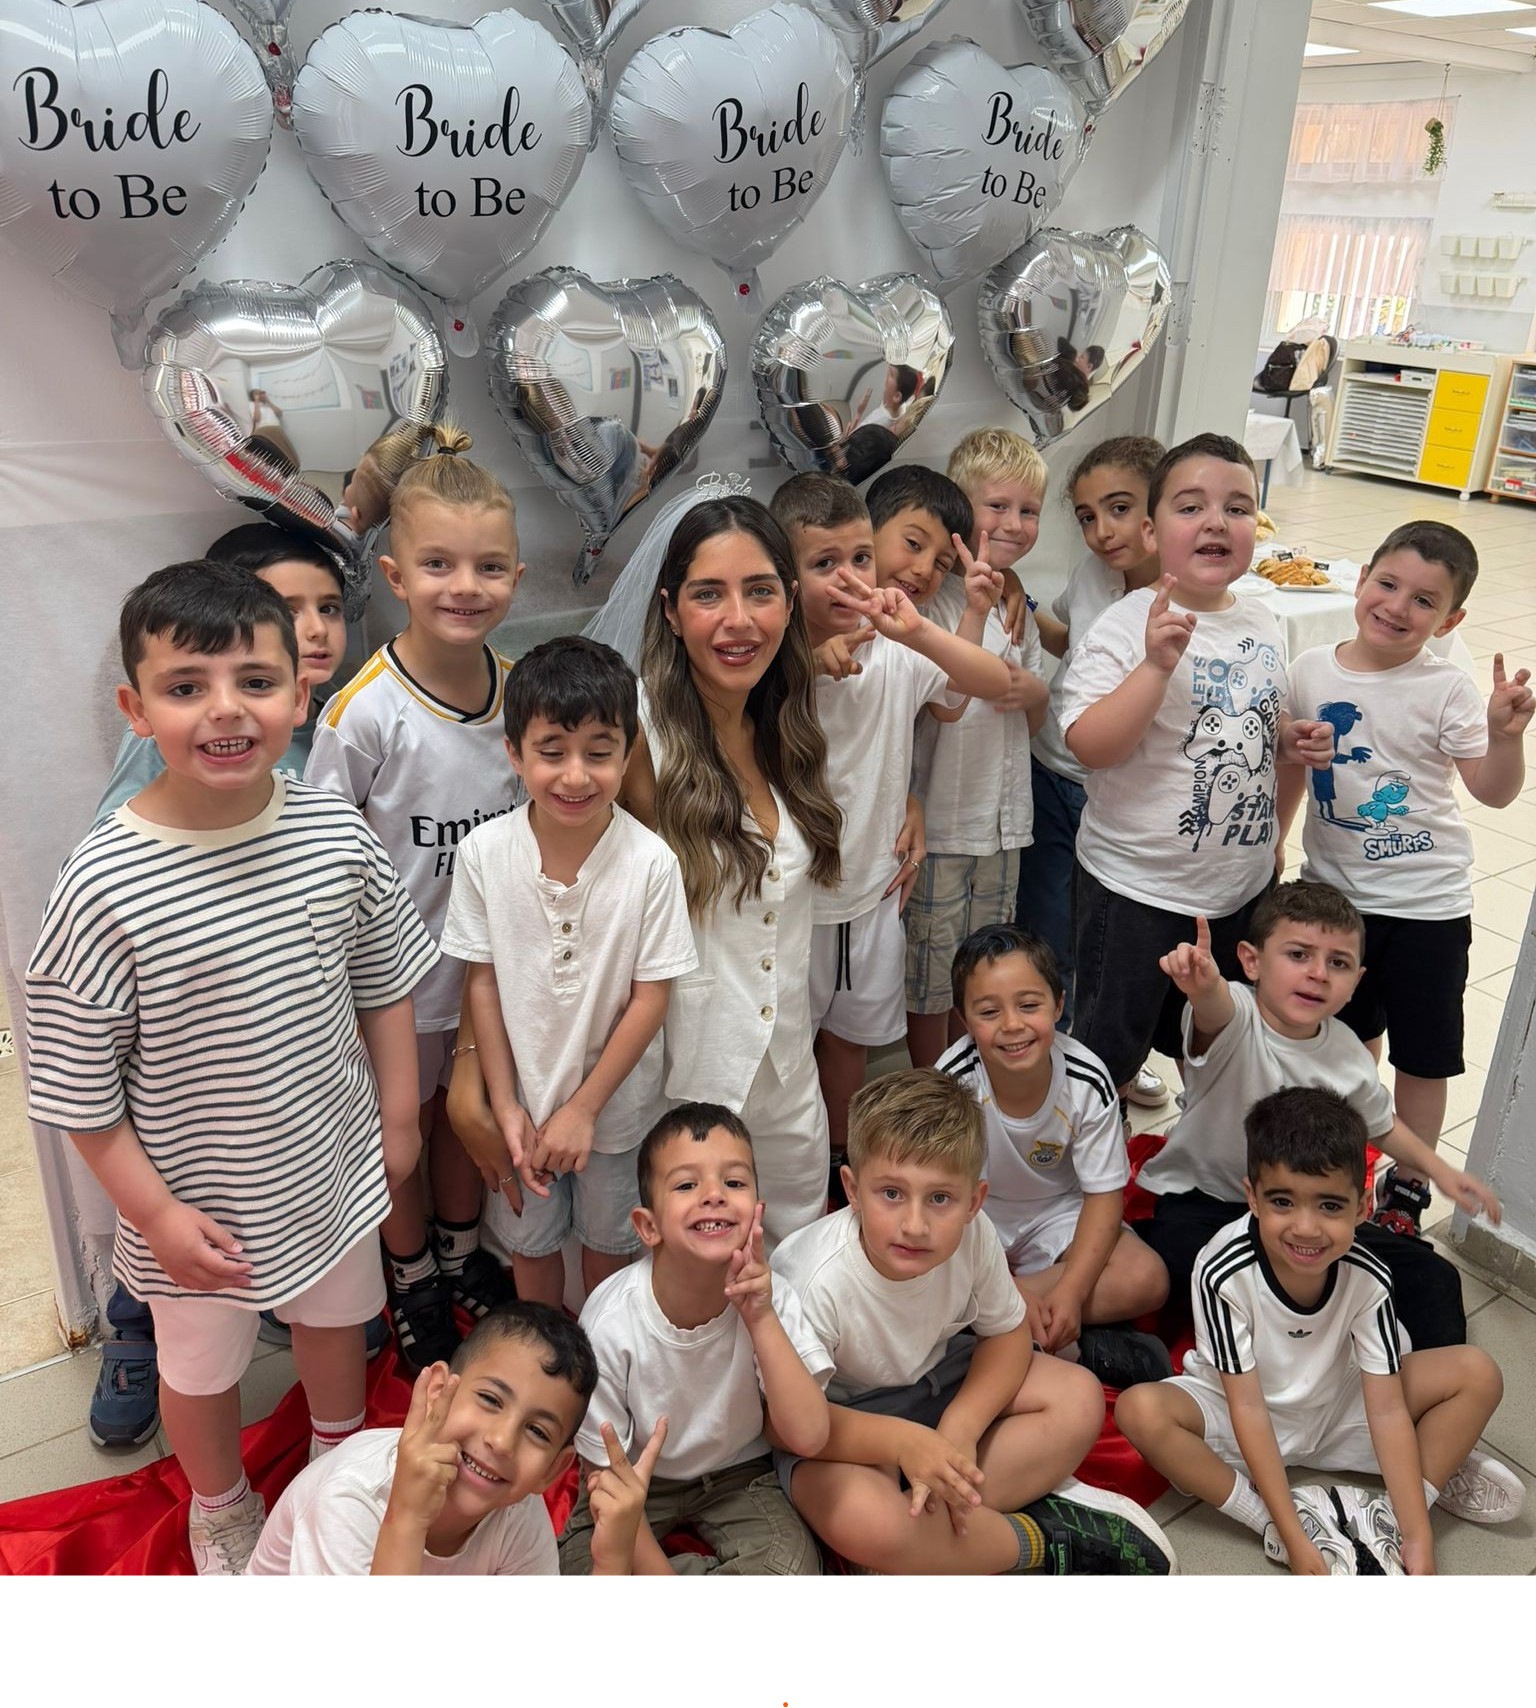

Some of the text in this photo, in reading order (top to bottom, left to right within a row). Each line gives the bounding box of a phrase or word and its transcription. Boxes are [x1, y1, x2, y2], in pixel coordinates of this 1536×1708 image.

[13, 67, 201, 152] Bride
[395, 84, 542, 158] Bride
[712, 82, 826, 163] Bride
[981, 91, 1065, 161] Bride
[47, 174, 187, 220] to Be
[414, 178, 526, 217] to Be
[728, 167, 814, 212] to Be
[981, 166, 1047, 209] to Be
[695, 471, 753, 499] Bride
[1206, 658, 1229, 707] GO
[1364, 831, 1434, 861] SMURFS
